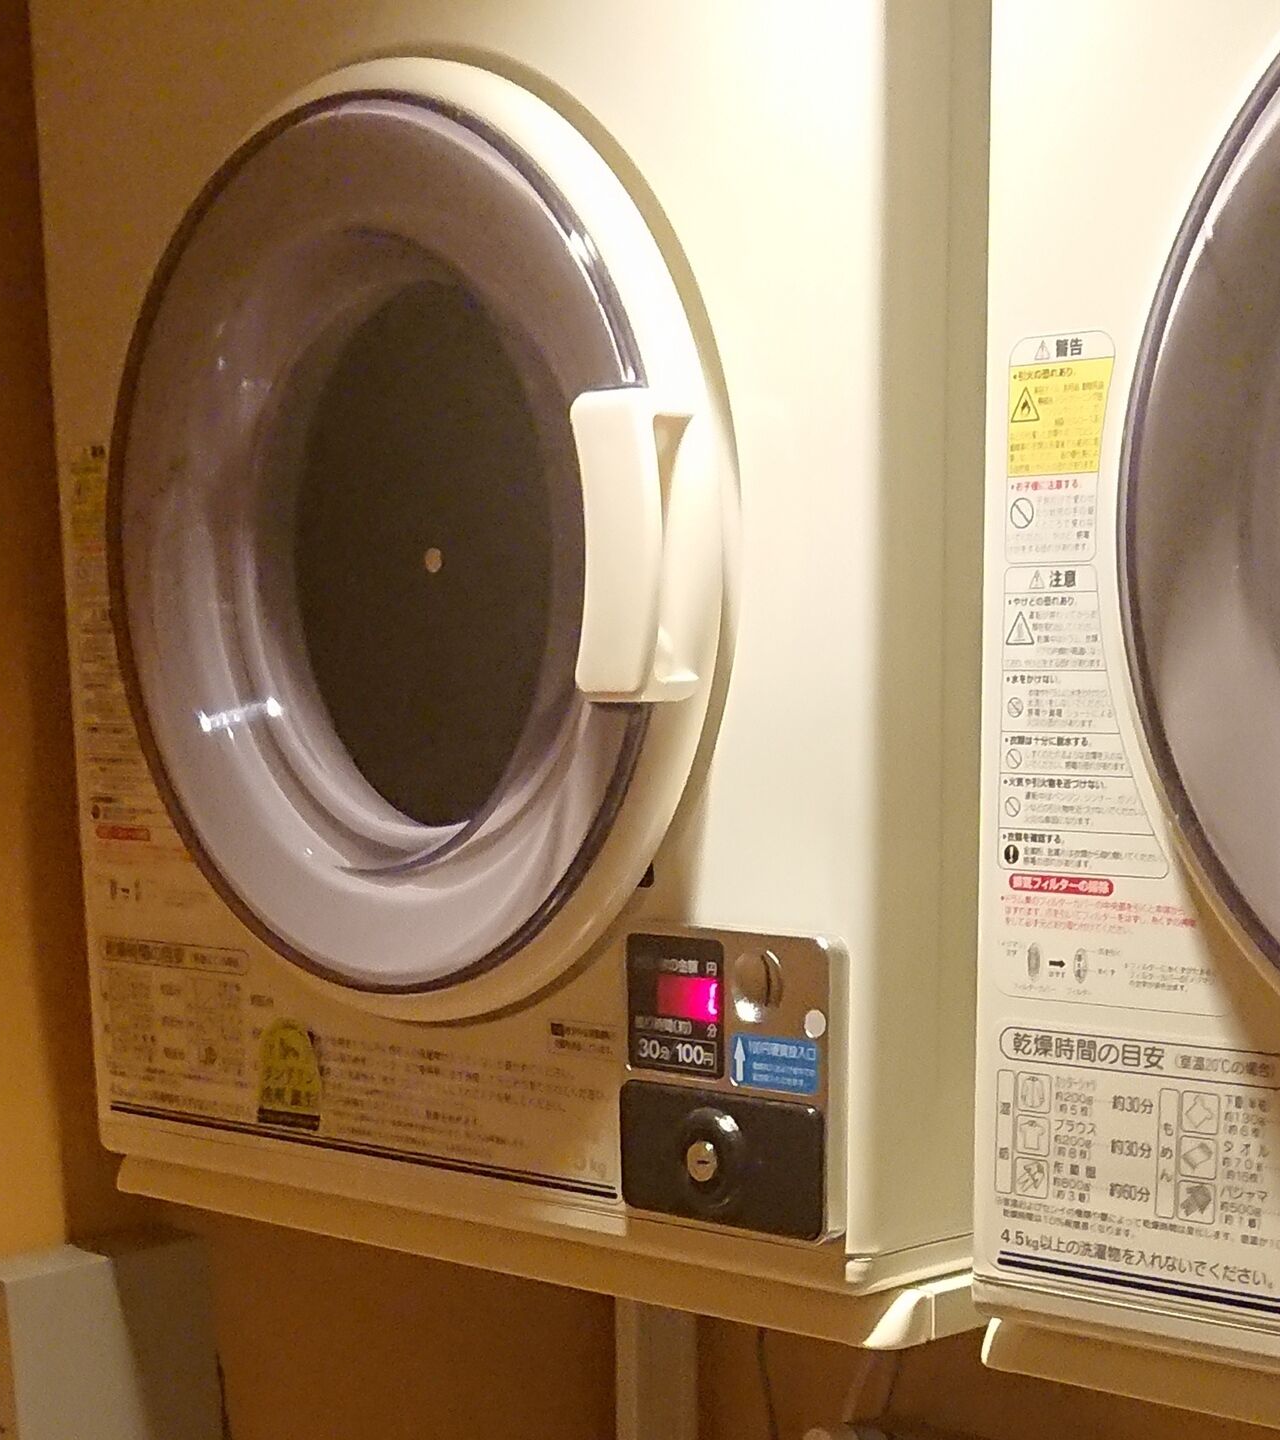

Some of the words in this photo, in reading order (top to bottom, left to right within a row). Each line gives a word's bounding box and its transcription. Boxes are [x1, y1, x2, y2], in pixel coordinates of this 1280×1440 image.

[1056, 338, 1083, 358] 警告
[1049, 570, 1076, 587] 注意
[1012, 1032, 1165, 1070] 乾燥時間の目安
